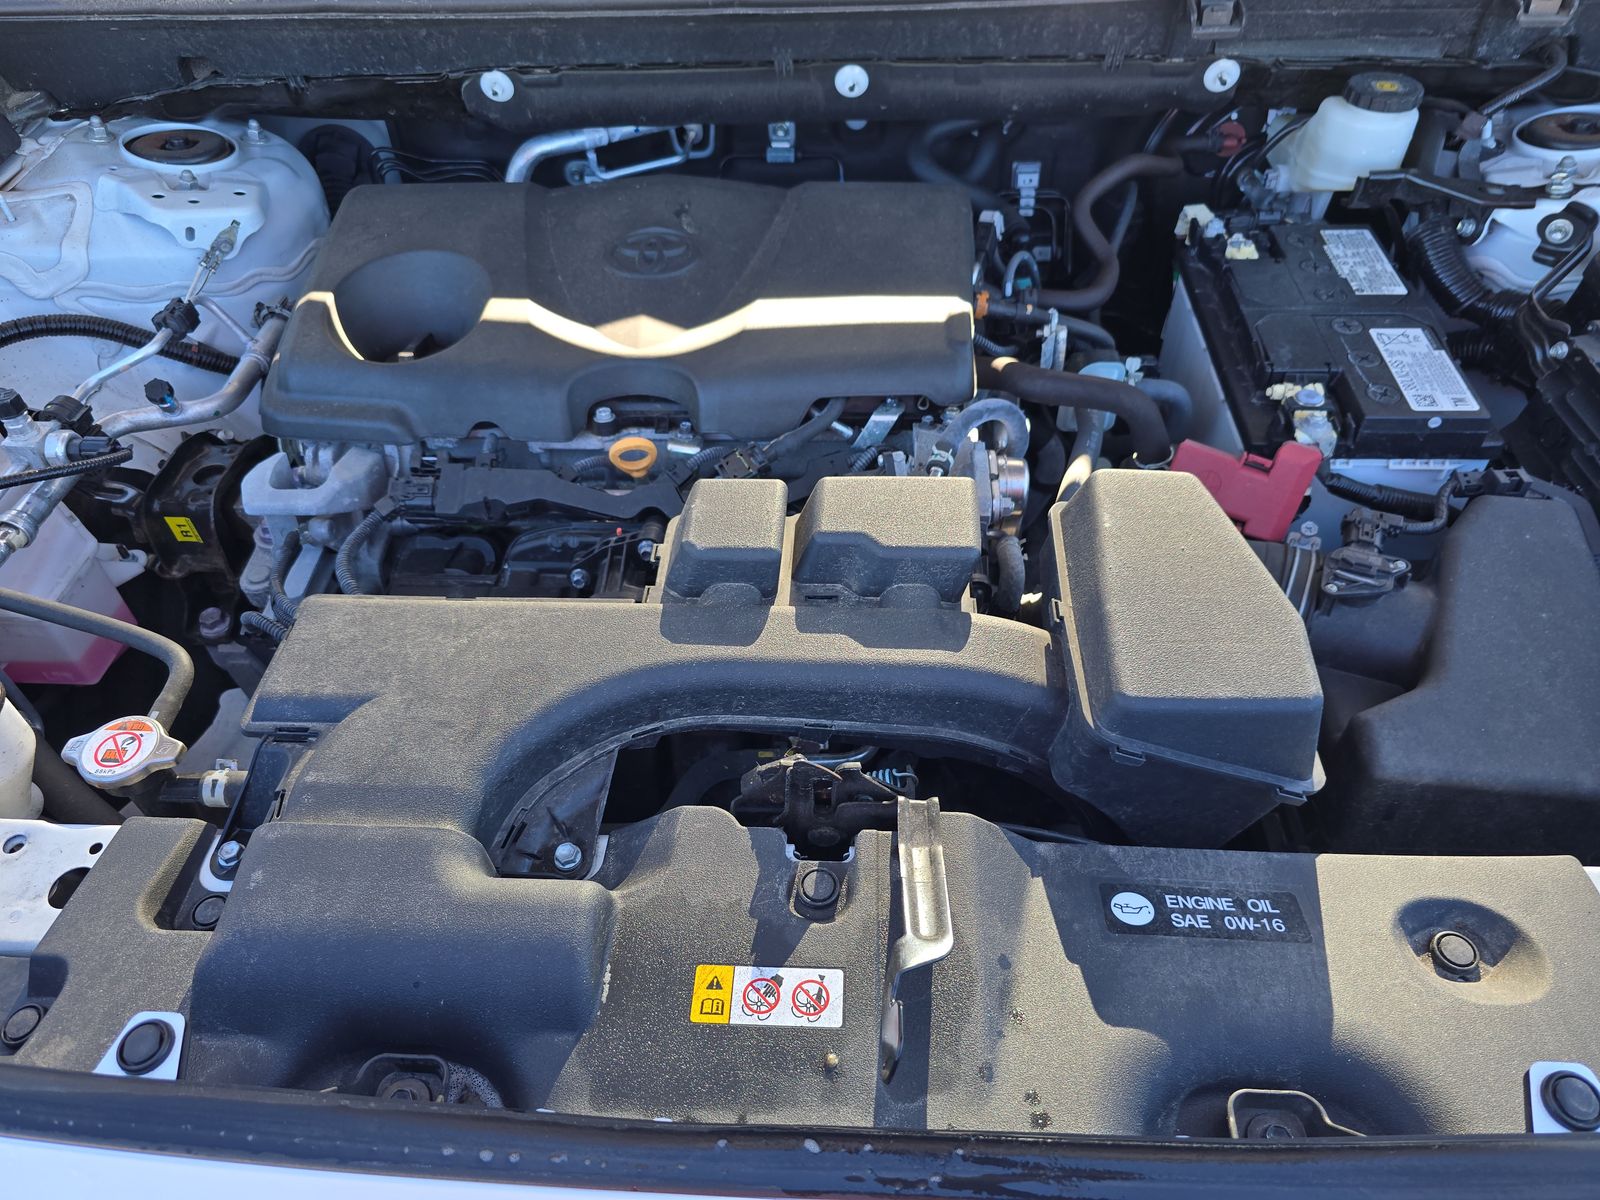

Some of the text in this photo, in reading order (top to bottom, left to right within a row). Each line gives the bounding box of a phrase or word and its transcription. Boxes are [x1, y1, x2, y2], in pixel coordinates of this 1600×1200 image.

[1164, 894, 1281, 914] ENGINE OIL
[1170, 913, 1286, 933] SAE 0W-16
